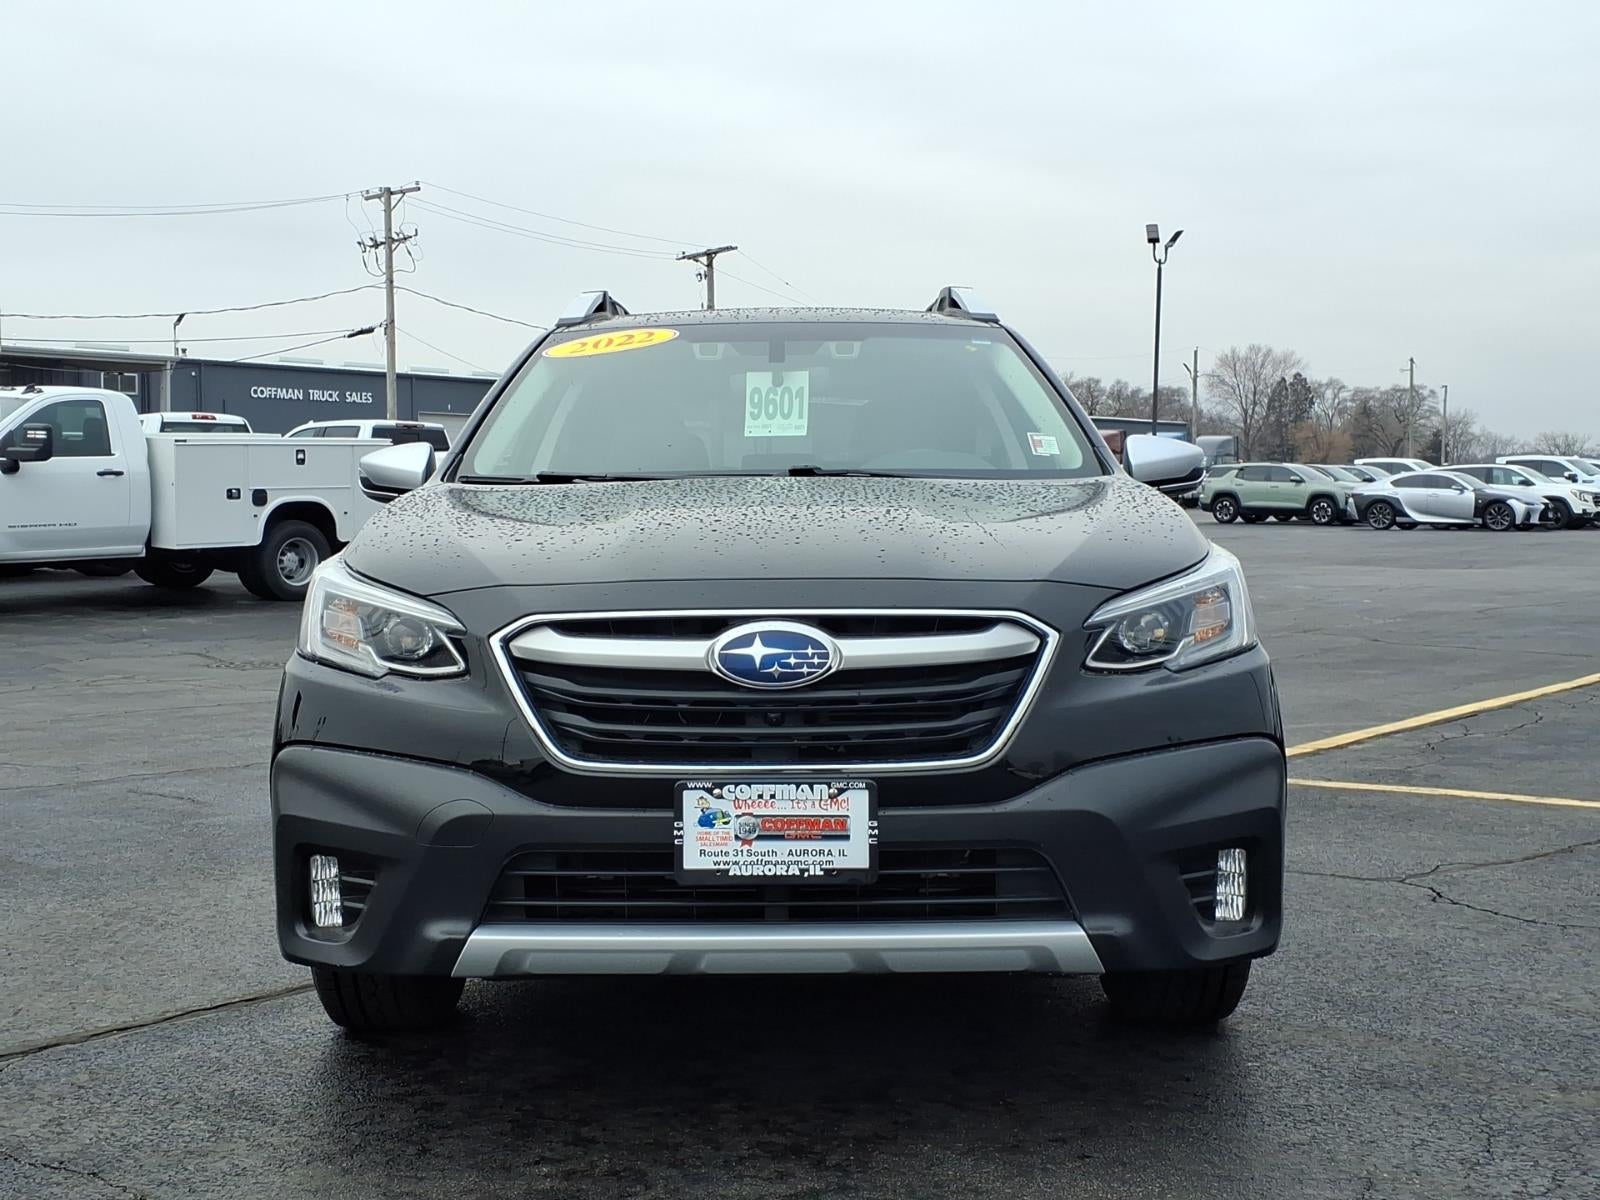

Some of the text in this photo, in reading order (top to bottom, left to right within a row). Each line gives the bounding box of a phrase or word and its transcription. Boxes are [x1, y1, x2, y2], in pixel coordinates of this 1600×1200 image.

[569, 332, 655, 354] 2022
[250, 386, 373, 403] COFFMAN TRUCK SALES
[749, 386, 804, 421] 9601
[686, 781, 866, 801] WWW. COFFMAN GMC.COM
[818, 798, 850, 811] GMC!
[739, 827, 757, 835] 1949
[760, 817, 849, 832] COFFMAN
[699, 848, 730, 858] Route
[732, 848, 744, 858] 31
[746, 848, 778, 858] South
[838, 848, 848, 857] IL
[712, 858, 835, 867] wwwcoffmangmccom
[728, 864, 800, 876] AURORA
